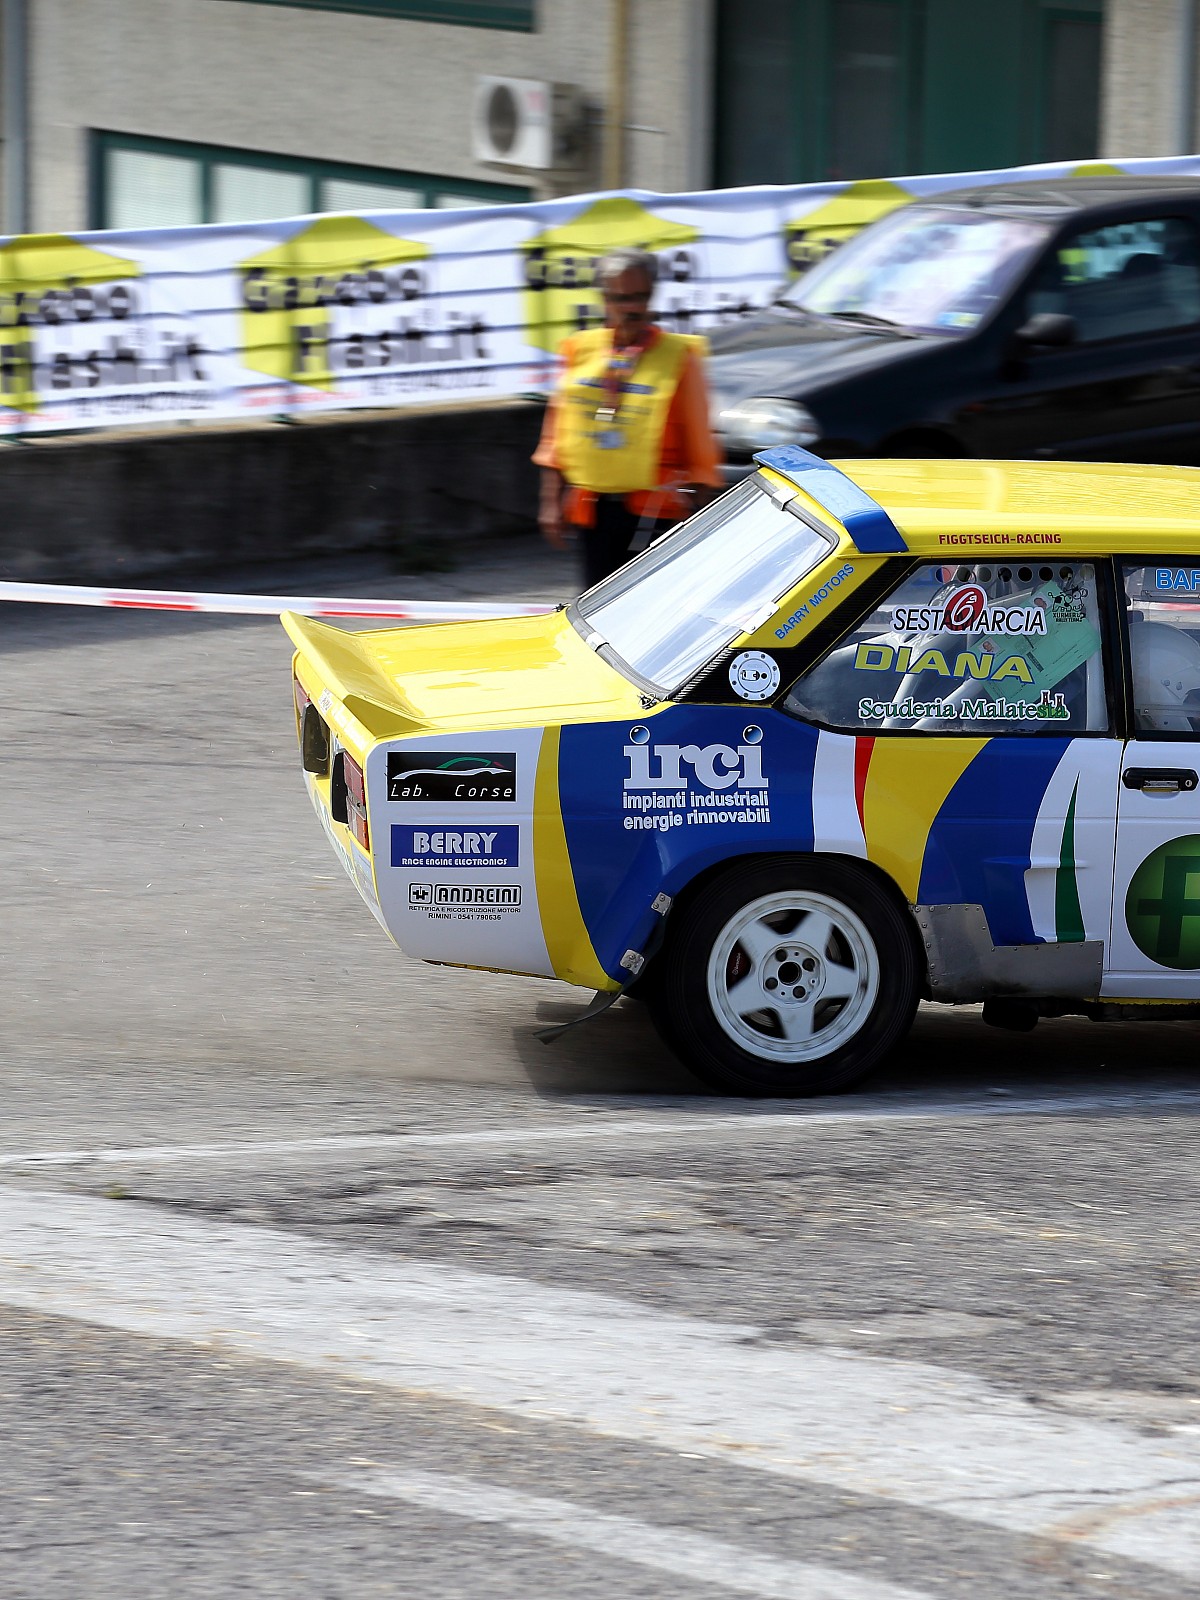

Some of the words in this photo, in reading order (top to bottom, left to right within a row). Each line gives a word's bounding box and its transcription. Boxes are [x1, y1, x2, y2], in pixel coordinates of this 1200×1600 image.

[939, 534, 1062, 545] FIGGTSEICH-RACING
[774, 604, 810, 640] BARRY
[809, 563, 855, 608] MOTORS
[854, 642, 1035, 684] DIANA
[859, 699, 955, 719] Scuderia
[623, 724, 769, 789] irci
[390, 784, 430, 797] Lab.
[455, 784, 513, 797] Corse
[622, 791, 686, 812] impianti
[690, 791, 768, 807] industriali
[623, 811, 683, 832] energie
[687, 808, 770, 824] rinnovabili
[413, 832, 498, 854] BERRY
[425, 858, 453, 866] ENGINE
[454, 858, 508, 866] ELECTRONICS
[438, 888, 518, 903] ANDREINI
